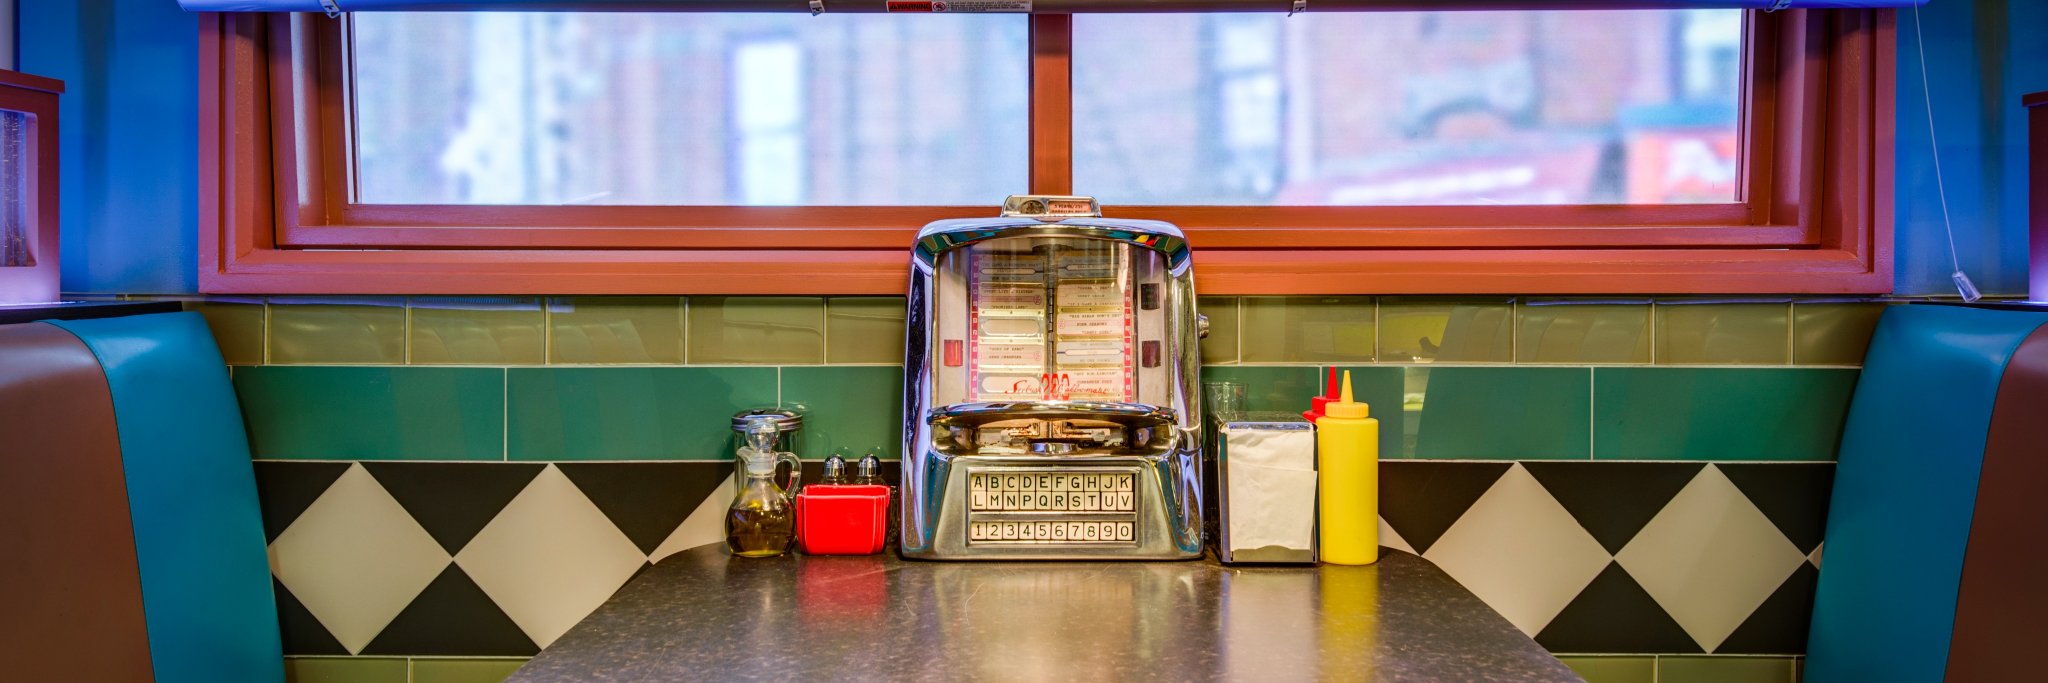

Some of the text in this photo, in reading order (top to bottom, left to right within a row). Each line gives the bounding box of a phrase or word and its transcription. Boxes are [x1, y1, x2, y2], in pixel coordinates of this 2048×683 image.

[974, 476, 1129, 488] A B C D E F G H J K
[975, 495, 1129, 507] L M N P Q R S T U V
[991, 525, 998, 535] 2
[1008, 525, 1014, 536] 3
[1023, 525, 1031, 536] 4
[1040, 525, 1046, 536] 5
[1055, 526, 1063, 536] 6
[1072, 526, 1079, 536] 7
[1088, 526, 1095, 537] 8
[1104, 526, 1112, 536] 9
